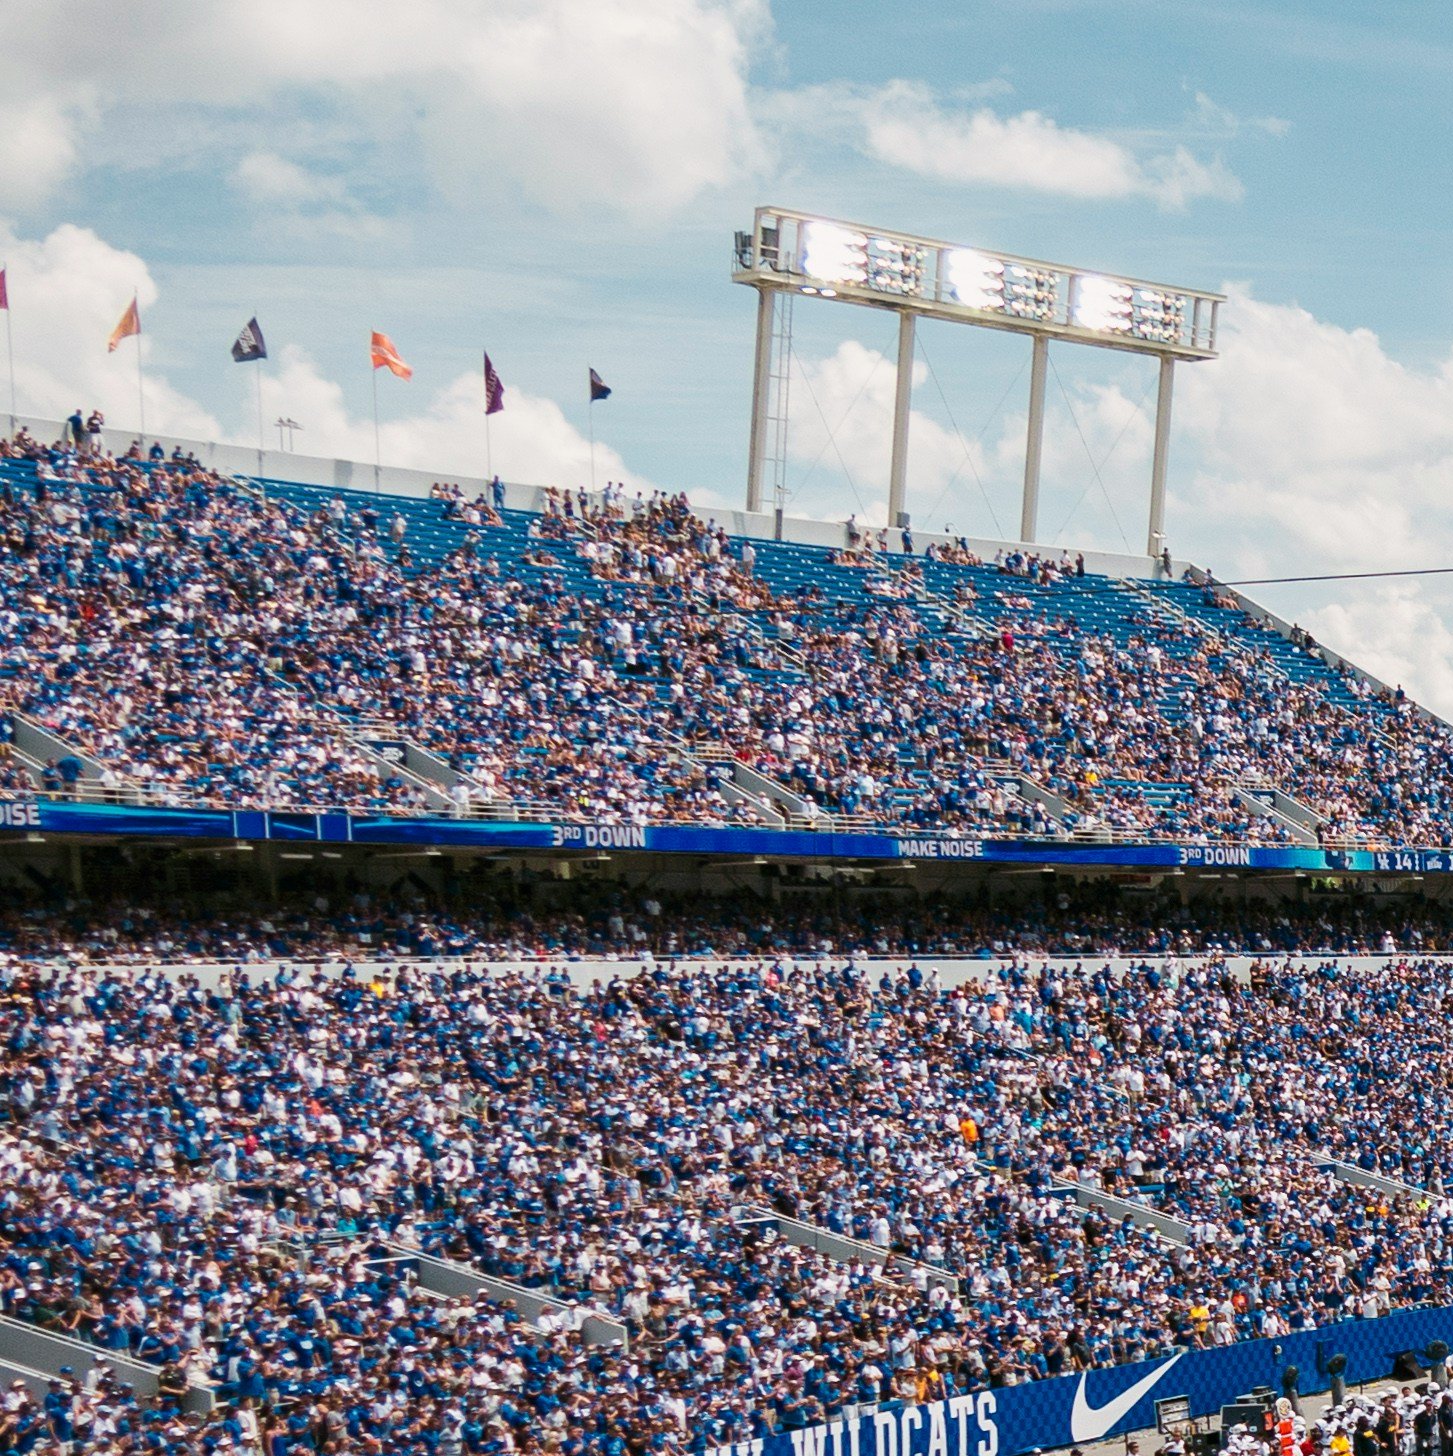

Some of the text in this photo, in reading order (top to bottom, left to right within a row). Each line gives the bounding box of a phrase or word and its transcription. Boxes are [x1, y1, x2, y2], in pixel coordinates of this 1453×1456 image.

[0, 803, 41, 825] ISE
[585, 826, 646, 847] DOWN
[898, 840, 983, 858] MAKE NOISE
[1204, 848, 1250, 866] DOWN
[1395, 853, 1413, 870] 14
